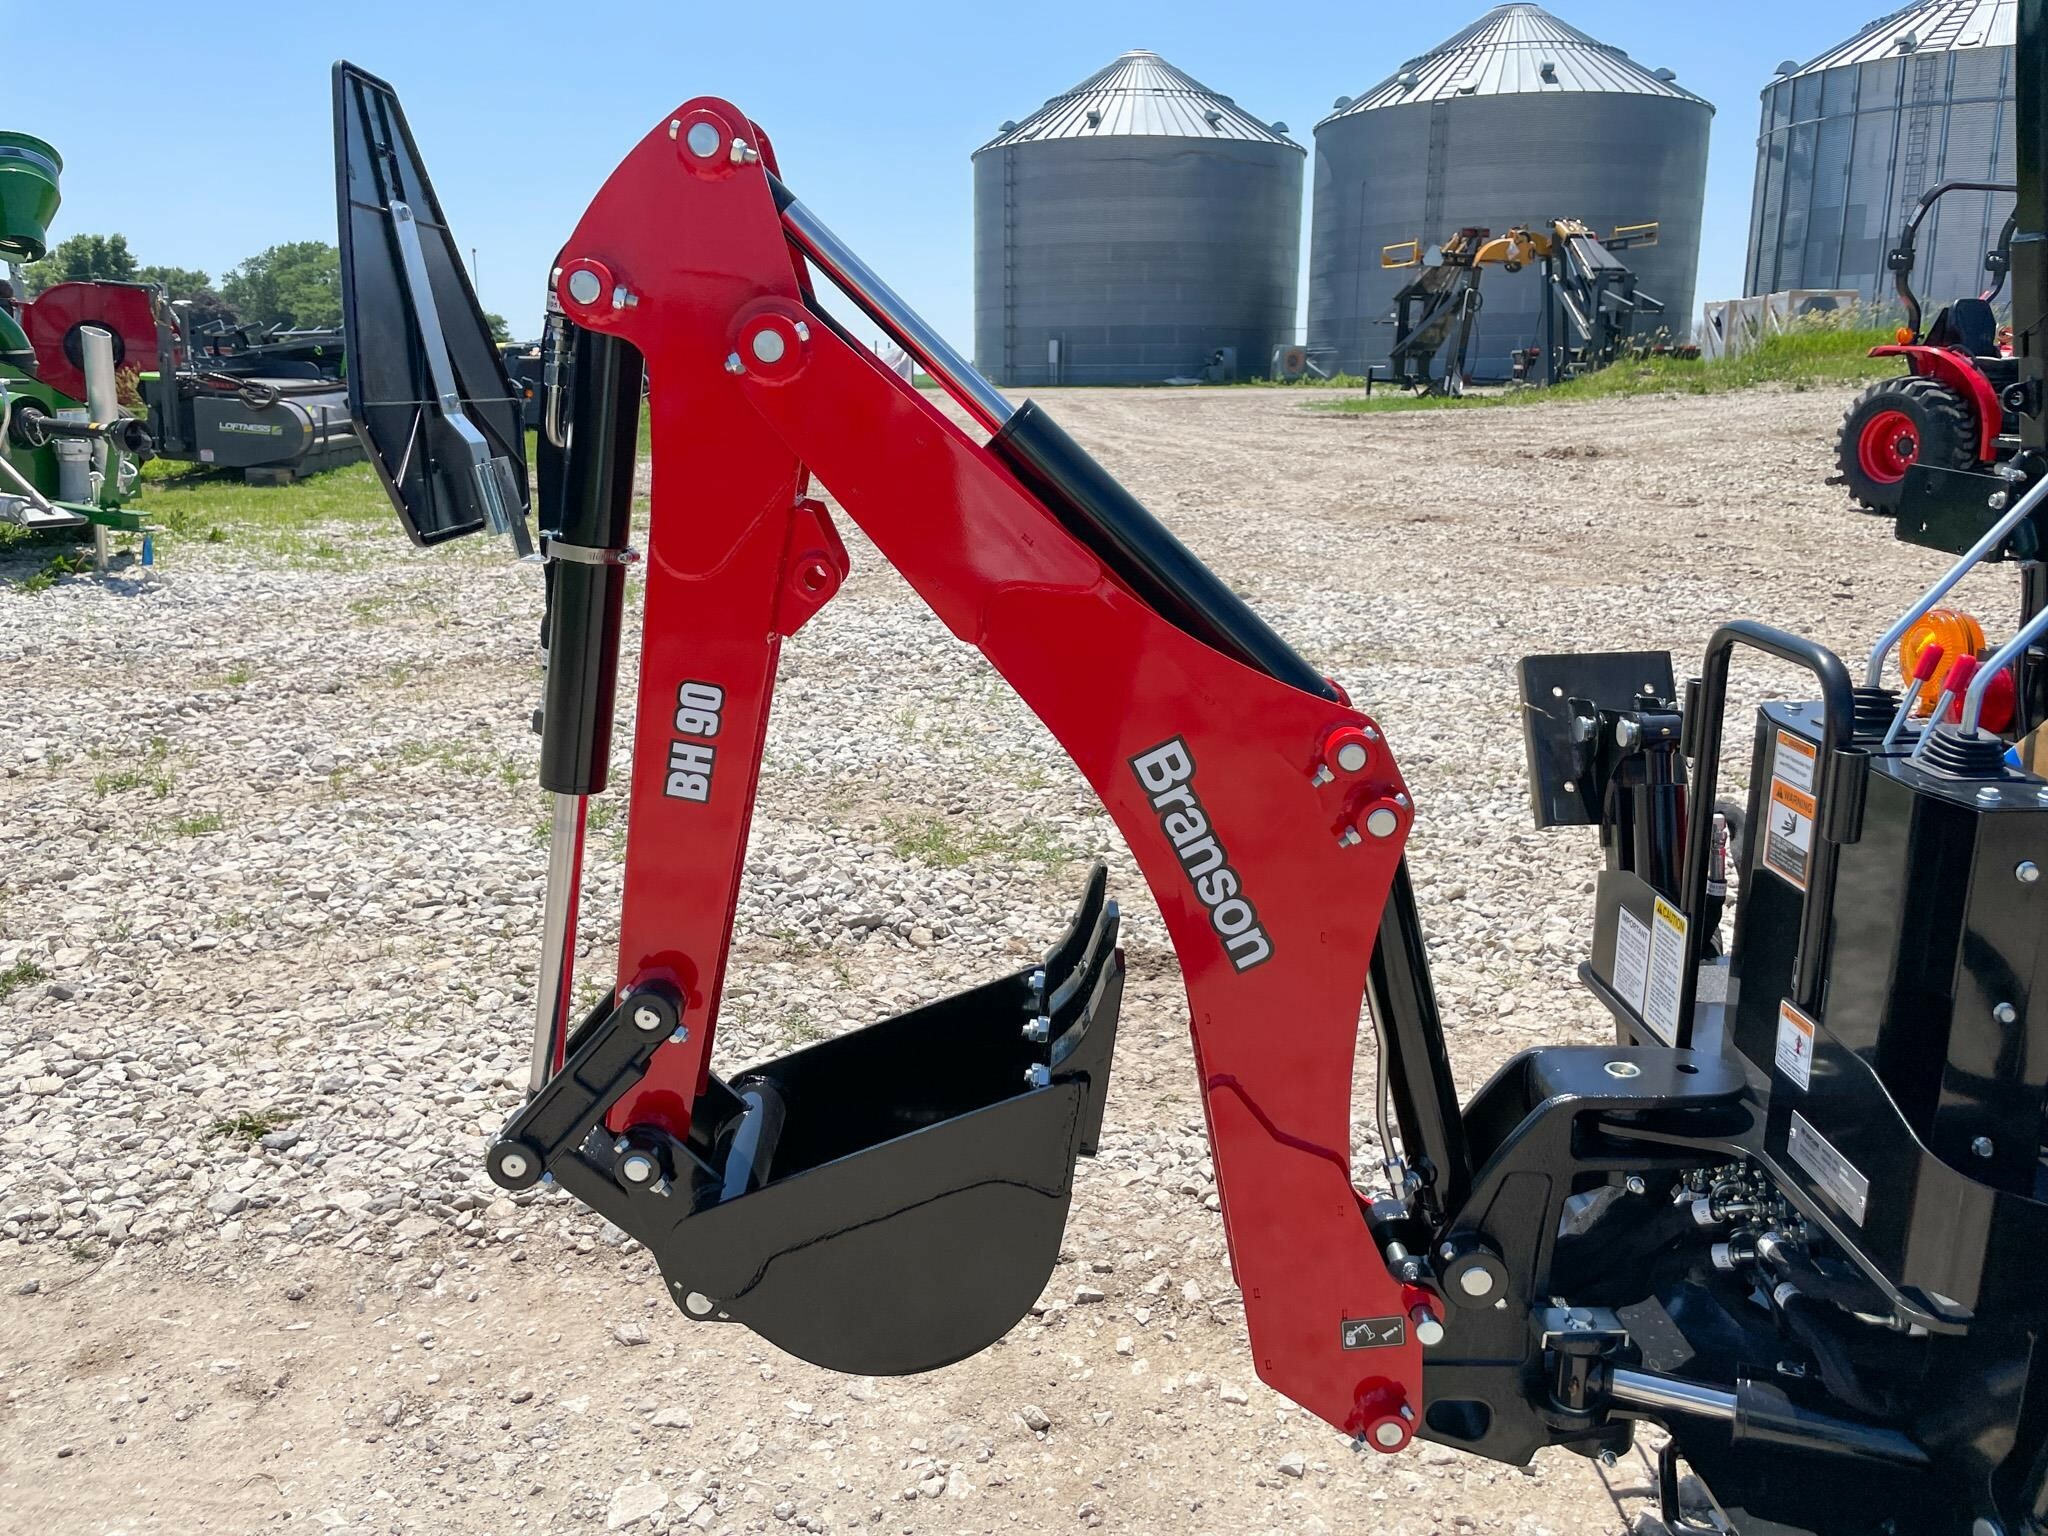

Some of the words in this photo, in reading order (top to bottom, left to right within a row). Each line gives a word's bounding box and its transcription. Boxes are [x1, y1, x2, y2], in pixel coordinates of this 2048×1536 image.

[218, 421, 271, 433] LOFTNESS
[675, 681, 723, 737] 90
[665, 740, 714, 801] BH
[1783, 790, 1813, 814] WARNING
[1131, 737, 1272, 971] Branson
[1621, 912, 1649, 942] IMPORTANT
[1661, 906, 1686, 933] CAUTION
